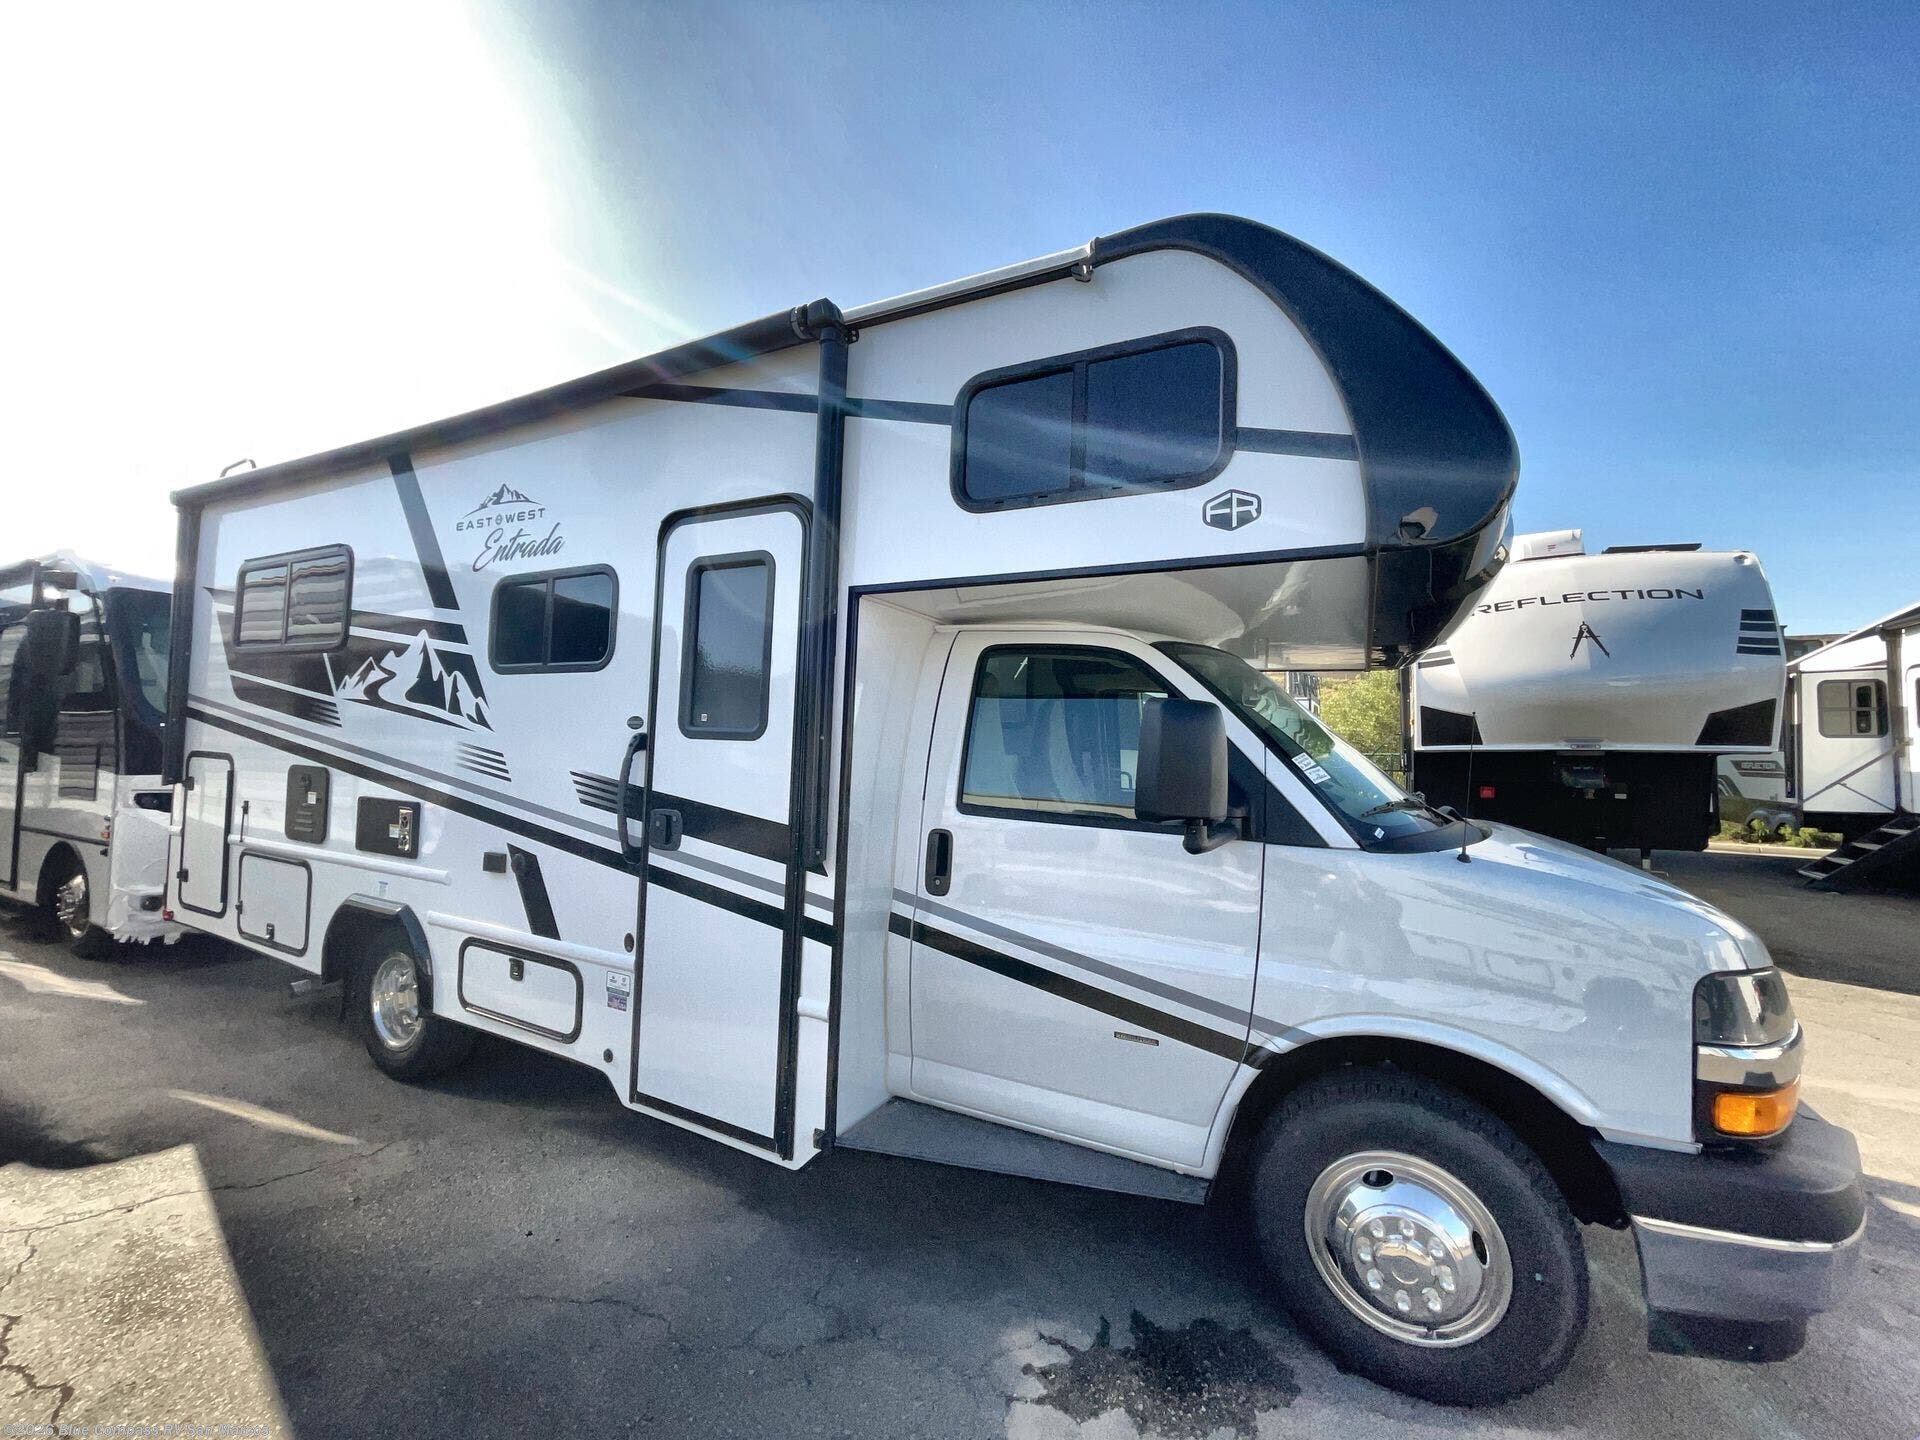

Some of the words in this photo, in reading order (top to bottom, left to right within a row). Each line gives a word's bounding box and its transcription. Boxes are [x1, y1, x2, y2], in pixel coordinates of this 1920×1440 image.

[456, 517, 493, 531] EAST
[505, 508, 546, 523] WEST
[472, 522, 566, 572] Entrada
